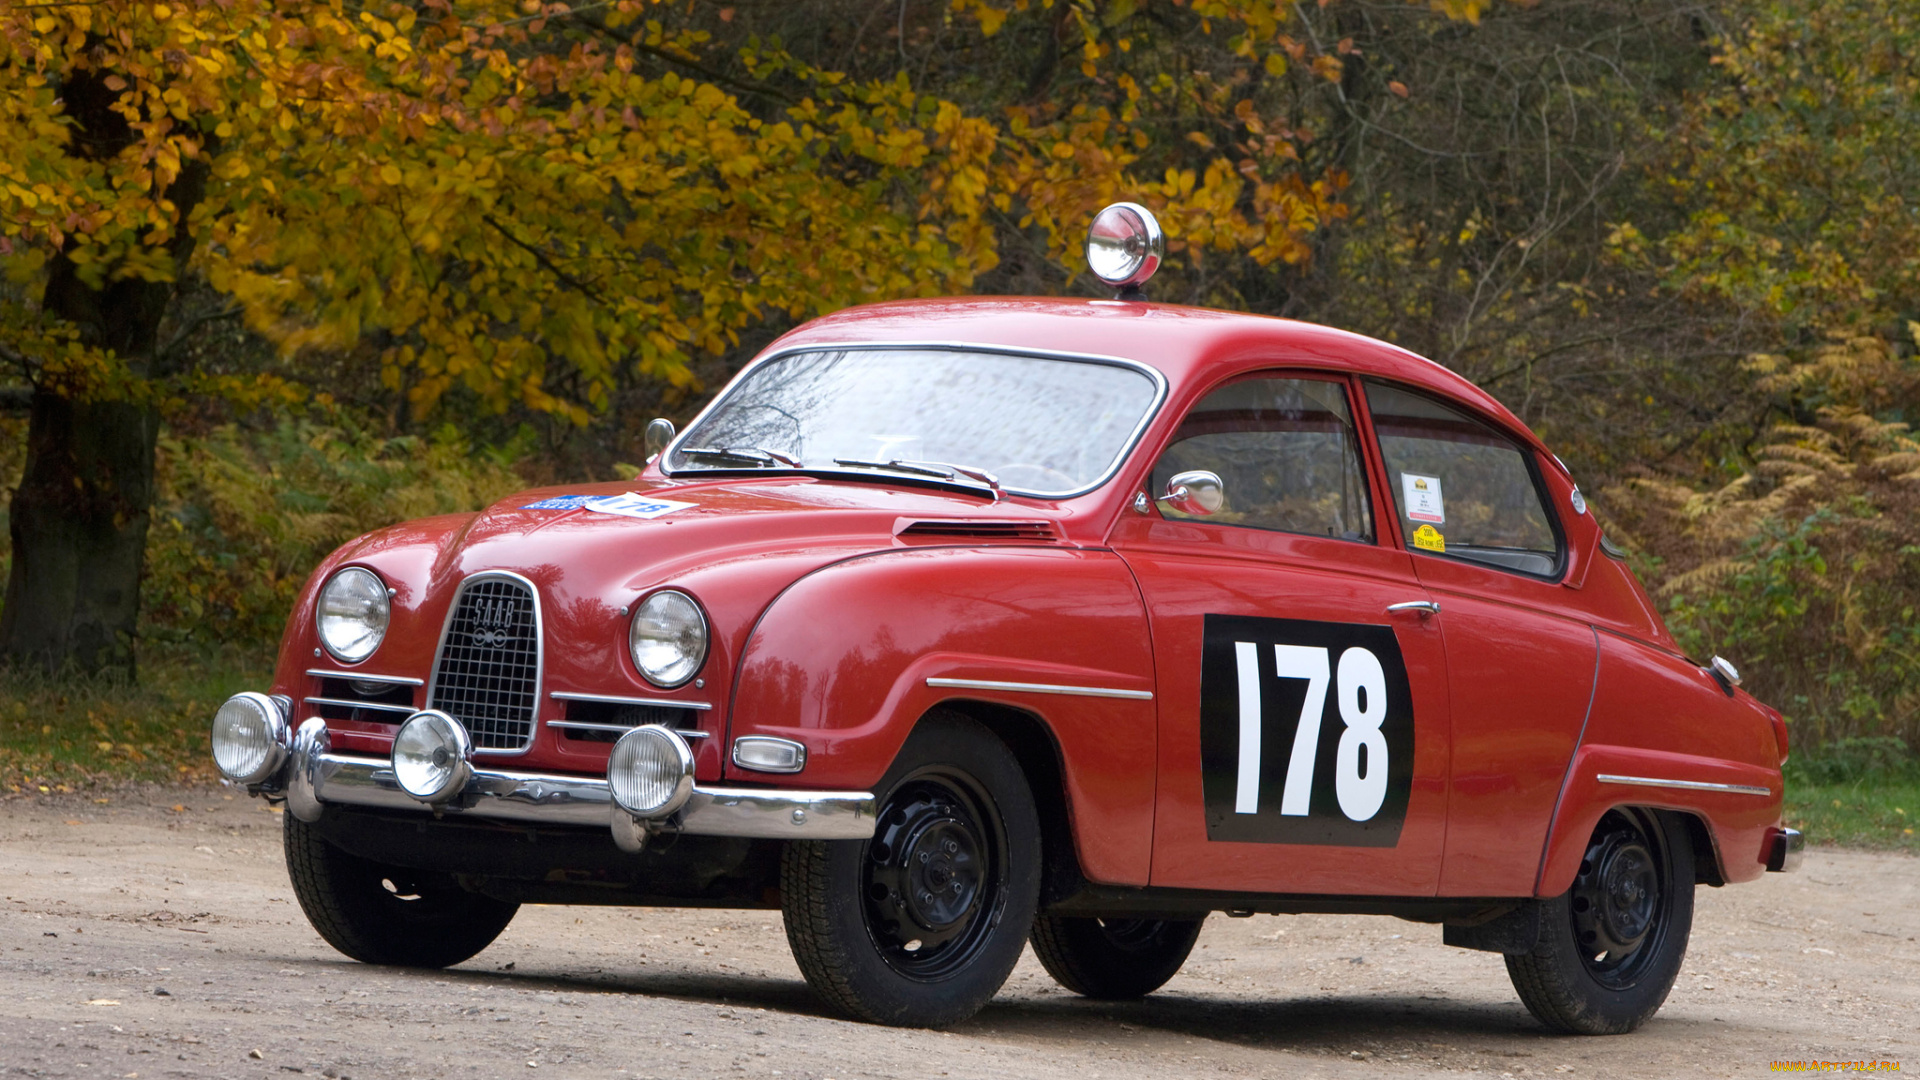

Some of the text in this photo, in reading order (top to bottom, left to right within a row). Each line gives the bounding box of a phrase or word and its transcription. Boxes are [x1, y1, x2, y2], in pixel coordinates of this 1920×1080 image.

[597, 497, 671, 513] 178
[472, 598, 515, 628] SAAB
[1234, 641, 1389, 822] 178
